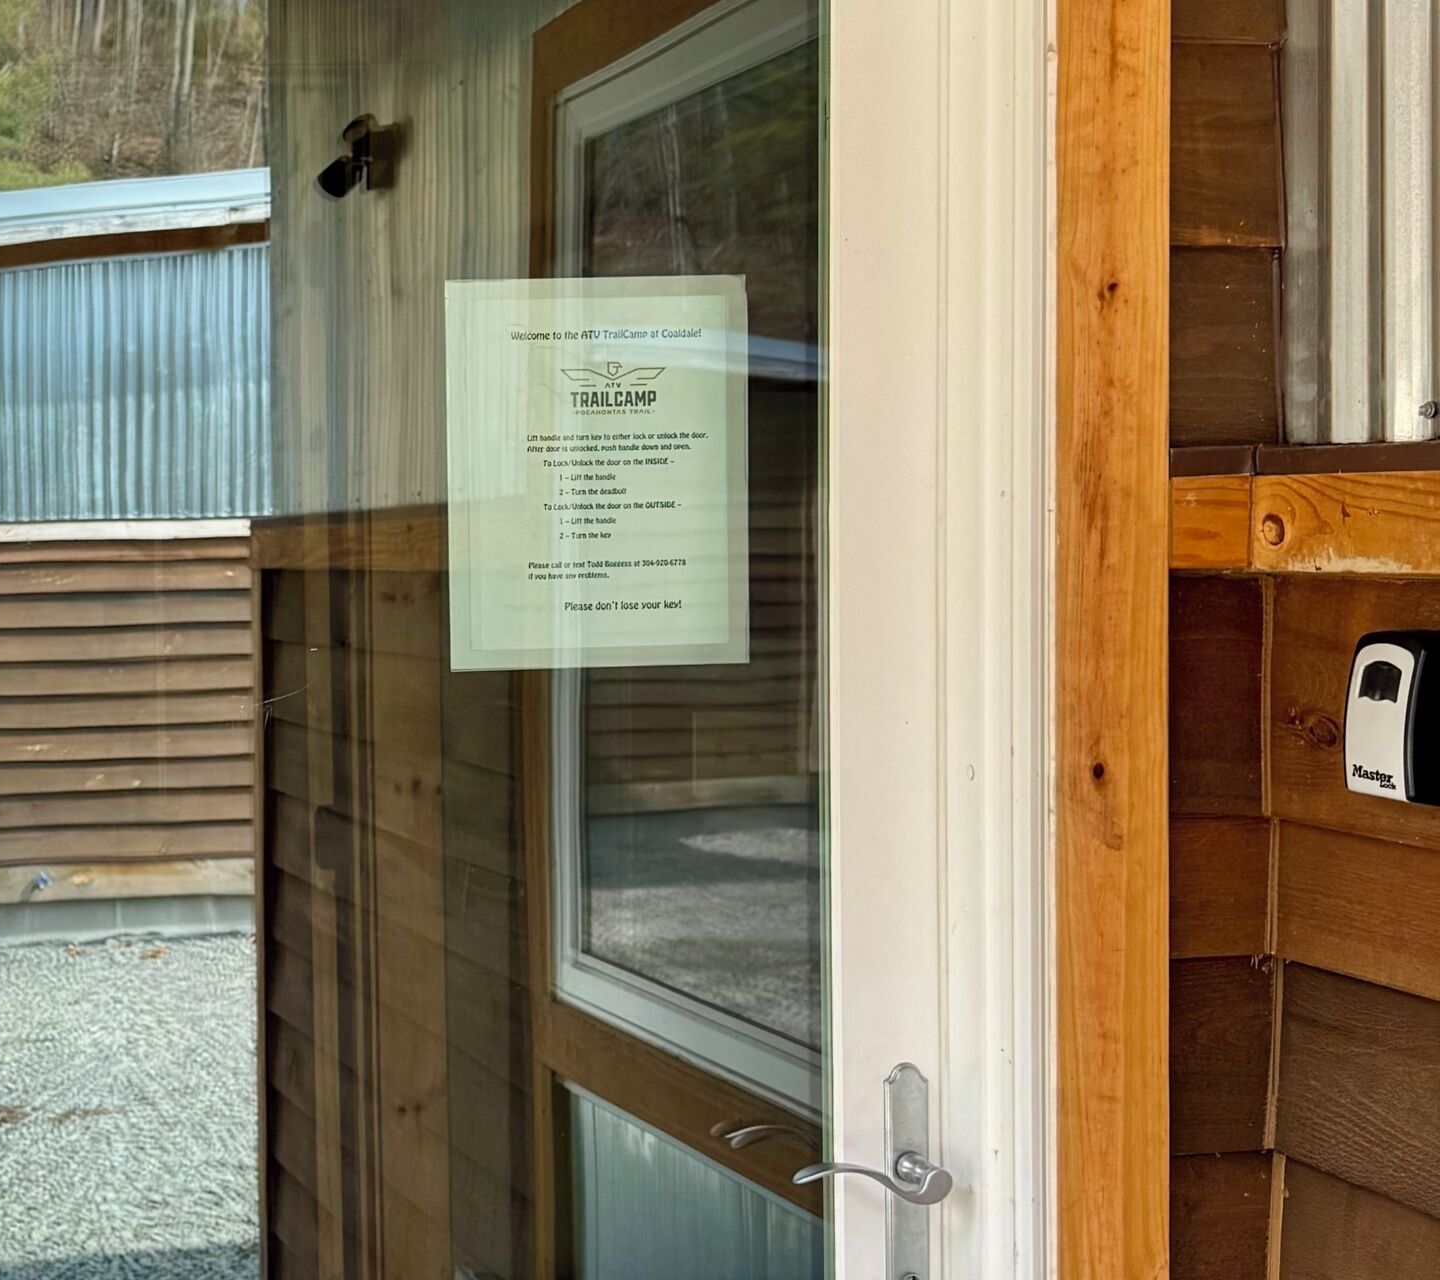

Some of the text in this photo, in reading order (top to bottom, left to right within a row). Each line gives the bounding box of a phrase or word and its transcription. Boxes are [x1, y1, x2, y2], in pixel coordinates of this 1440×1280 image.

[510, 328, 702, 341] Welcome to the ATV TrailCamp at Coaldale!
[570, 390, 656, 408] TRAILCAMP
[553, 458, 593, 467] Lock/Unlock
[600, 487, 626, 495] deadbolt
[554, 502, 594, 510] Lock/Unlock
[564, 600, 682, 611] Please don't lose your key!
[1352, 764, 1393, 784] Master
[1380, 780, 1396, 790] Lock
